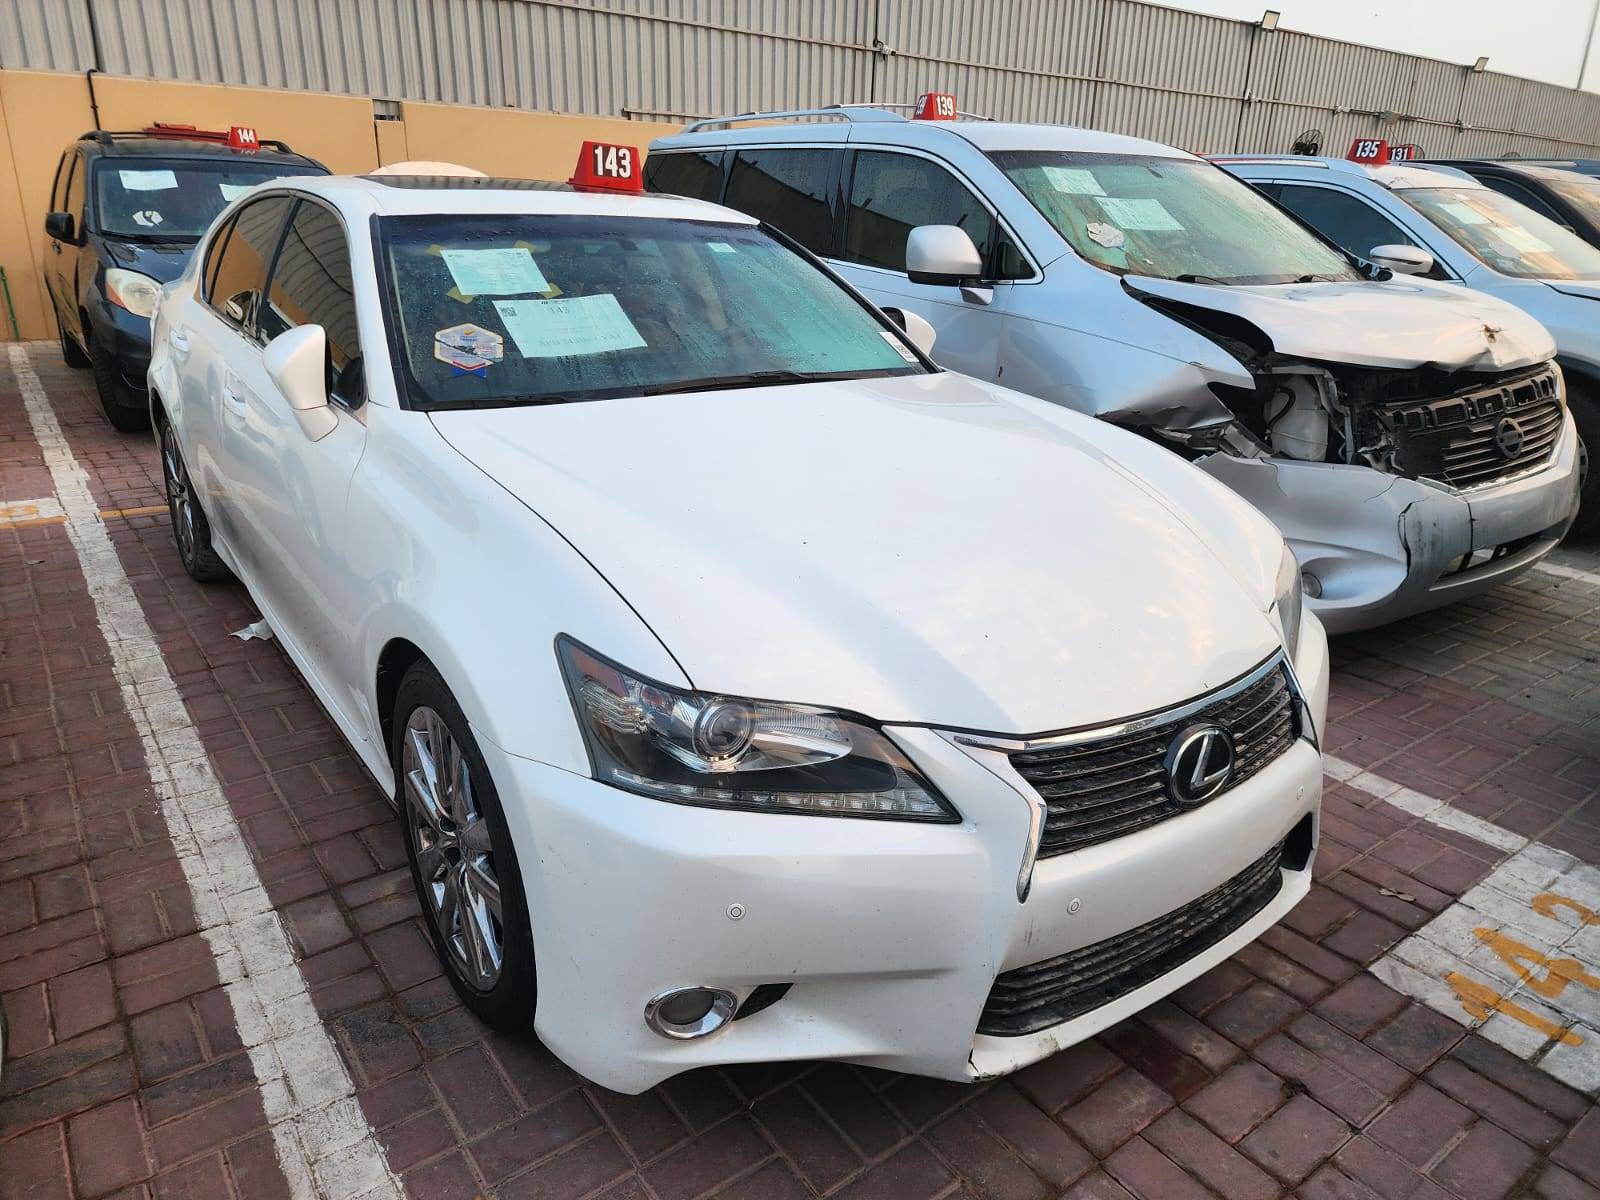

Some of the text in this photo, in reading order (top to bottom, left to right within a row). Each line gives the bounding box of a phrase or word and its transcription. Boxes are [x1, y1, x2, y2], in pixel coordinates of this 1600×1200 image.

[936, 95, 954, 117] 139
[237, 128, 255, 144] 144
[1355, 141, 1380, 158] 135
[1391, 147, 1409, 160] 131
[594, 145, 632, 178] 143
